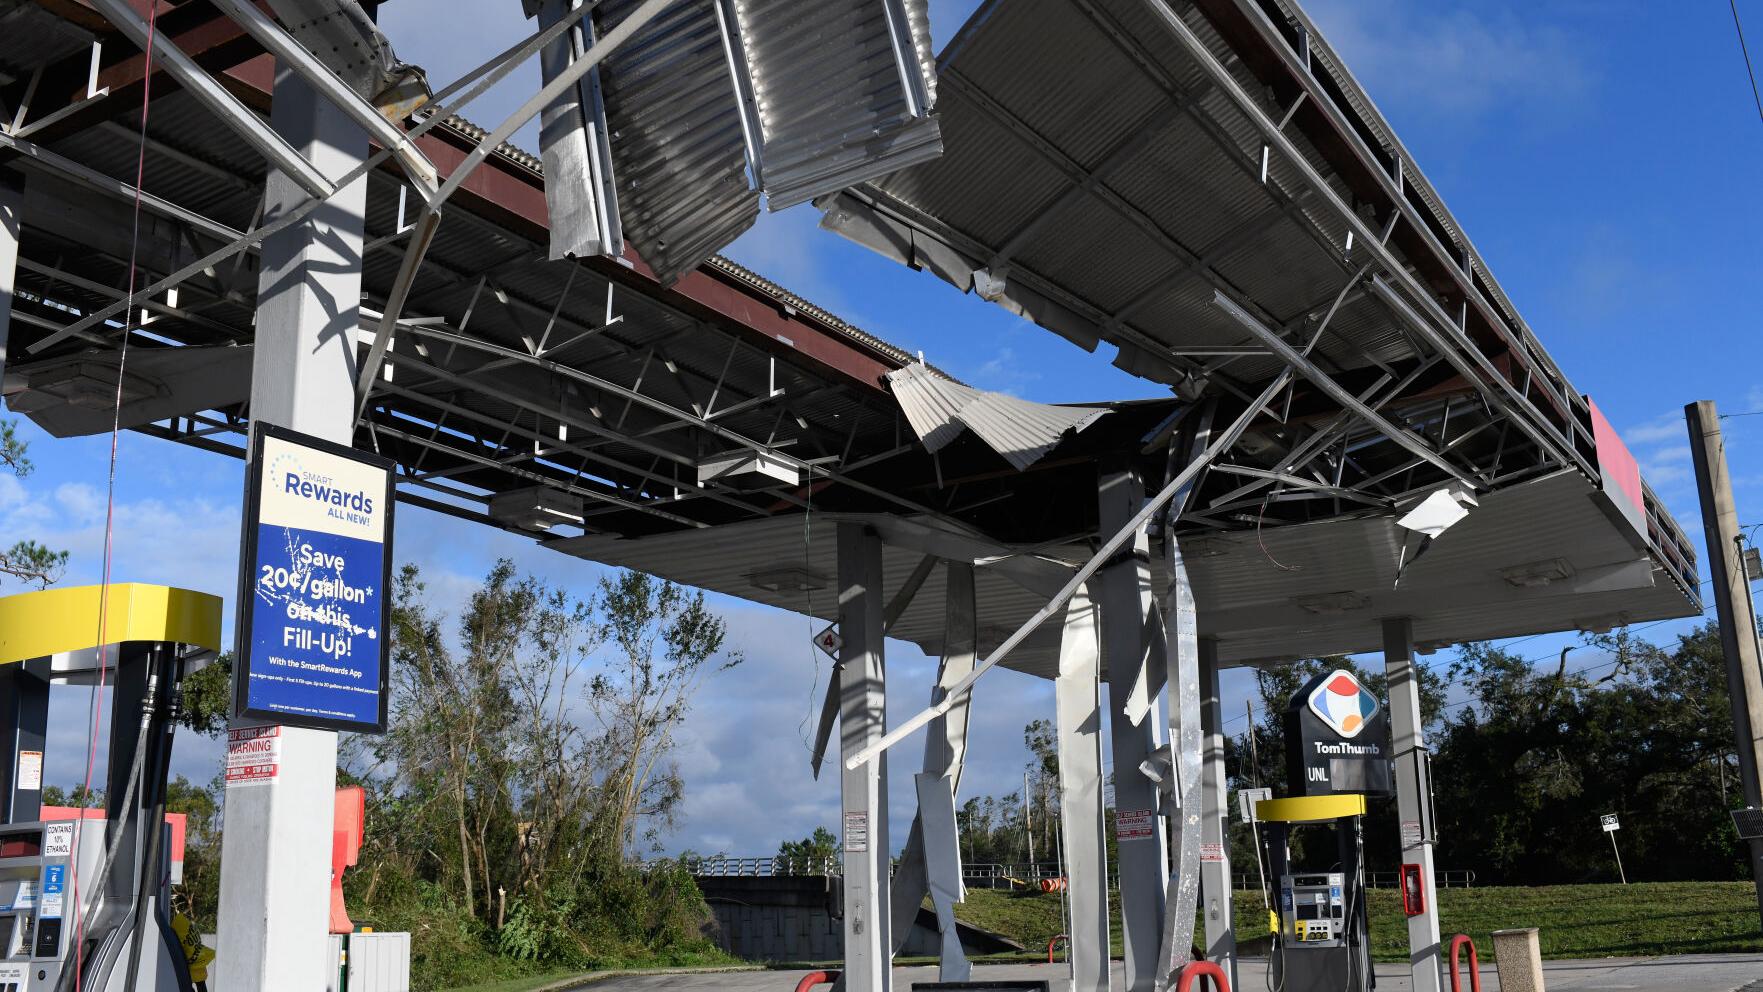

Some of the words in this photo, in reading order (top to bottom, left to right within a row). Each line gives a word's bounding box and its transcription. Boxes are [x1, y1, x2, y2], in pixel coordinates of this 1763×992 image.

[303, 471, 333, 486] SMART
[285, 472, 372, 514] Rewards
[327, 508, 344, 520] ALL
[346, 512, 370, 526] NEW!
[300, 544, 344, 571] Save
[287, 602, 312, 621] on
[316, 605, 351, 628] this
[284, 627, 351, 659] Fill-Up!
[823, 634, 834, 648] 4
[269, 656, 286, 666] With
[288, 659, 299, 668] the
[300, 660, 348, 675] SmartRewards
[349, 669, 363, 678] App
[229, 740, 271, 754] WARNING
[1314, 742, 1380, 754] TomThumb
[1307, 767, 1328, 782] UNL
[48, 825, 71, 834] CONTAINS
[54, 835, 63, 843] 10%
[46, 844, 69, 853] ETHANOL
